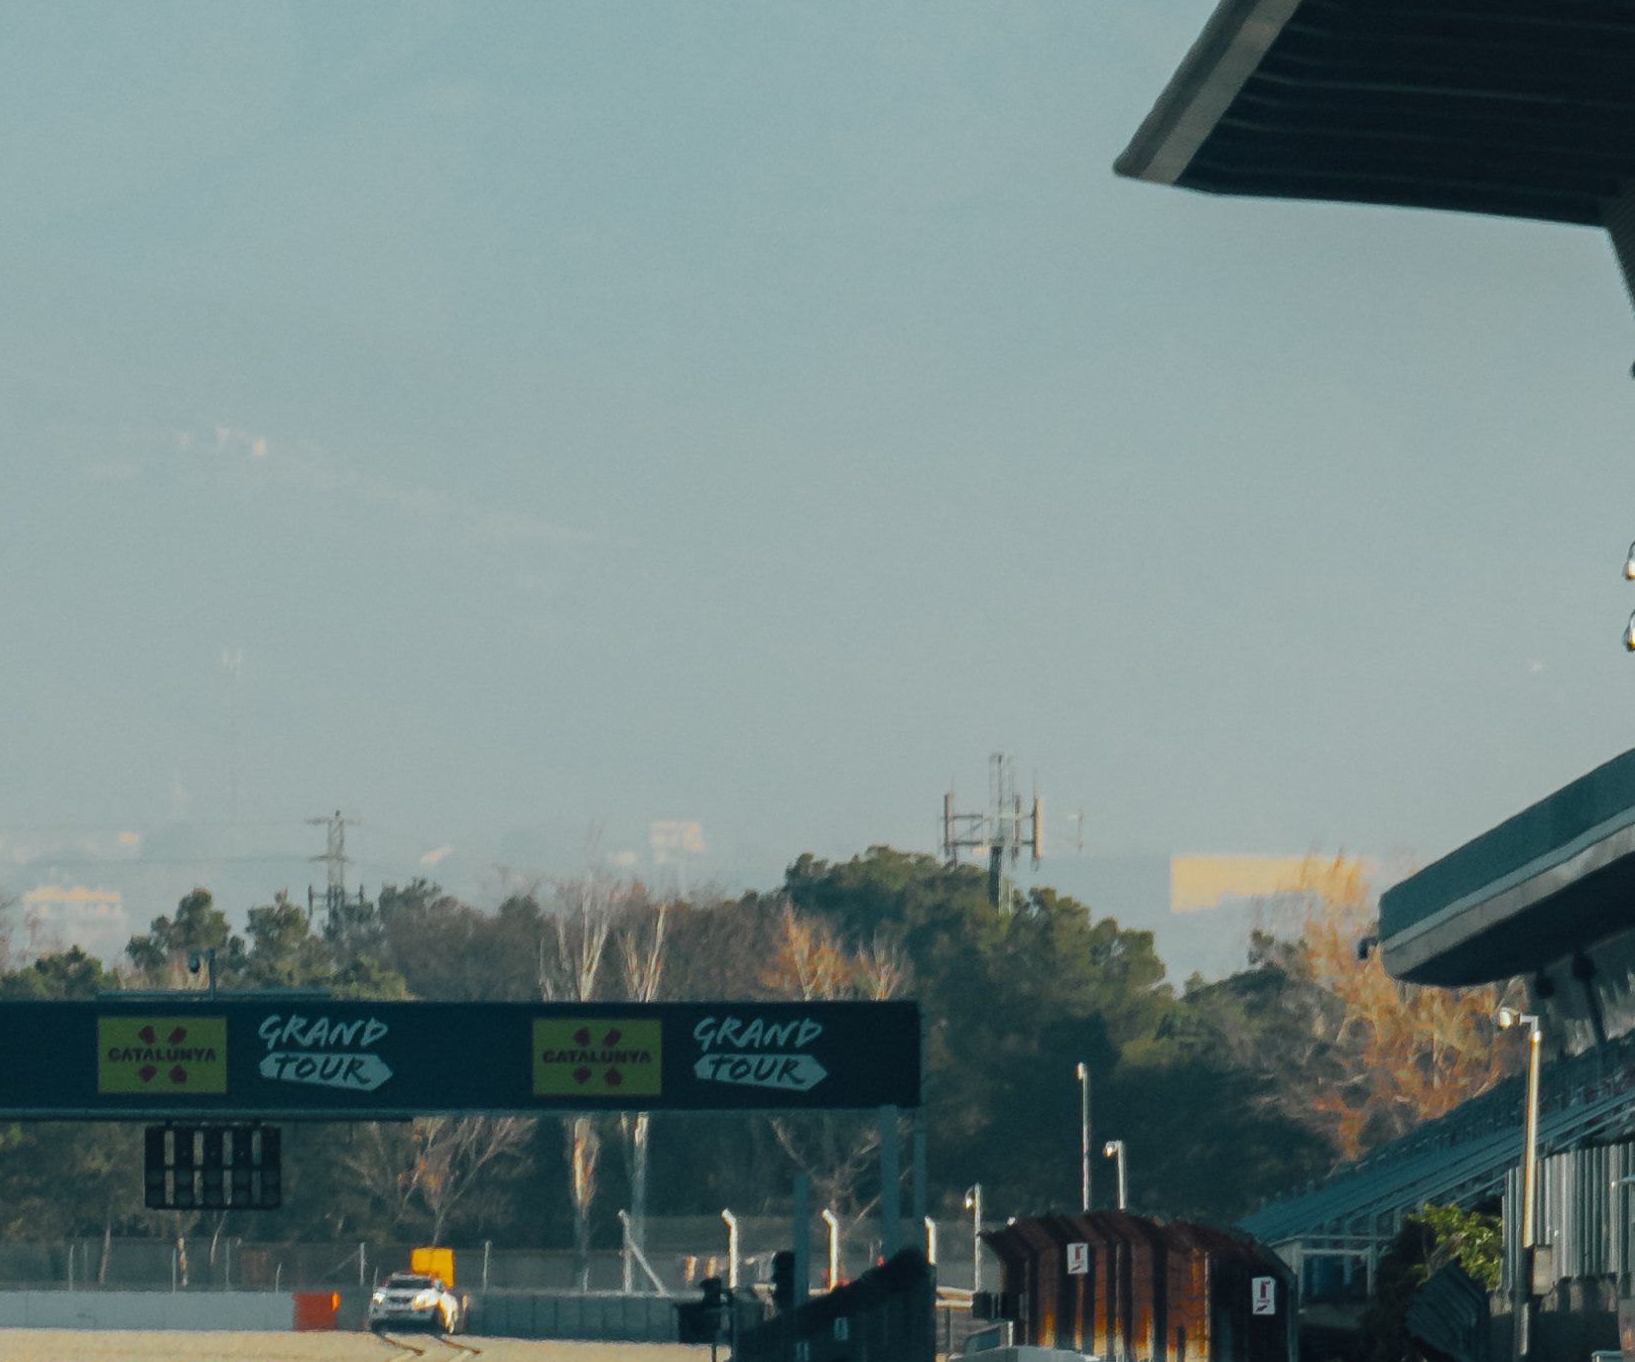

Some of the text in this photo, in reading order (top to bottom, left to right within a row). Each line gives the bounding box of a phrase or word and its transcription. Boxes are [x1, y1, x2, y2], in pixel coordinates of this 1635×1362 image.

[258, 1013, 389, 1050] GRAND
[693, 1015, 824, 1052] GRAND
[107, 1046, 216, 1064] CATALUNYA
[275, 1053, 372, 1084] TOUR
[542, 1048, 652, 1065] CATALUNYA
[708, 1055, 806, 1086] TOUR
